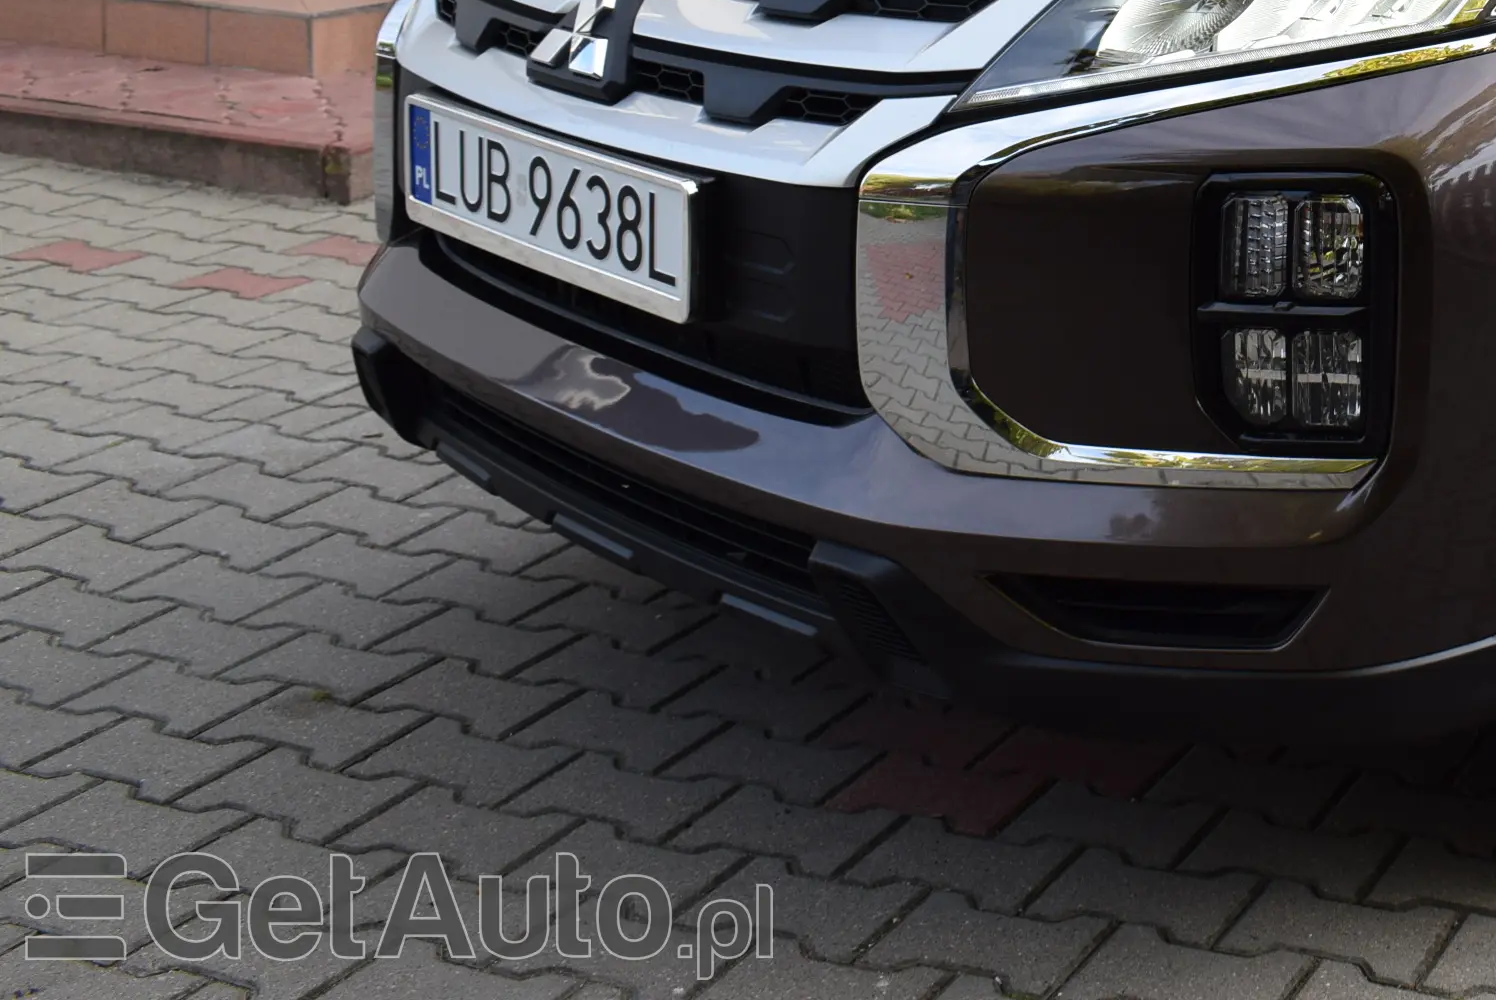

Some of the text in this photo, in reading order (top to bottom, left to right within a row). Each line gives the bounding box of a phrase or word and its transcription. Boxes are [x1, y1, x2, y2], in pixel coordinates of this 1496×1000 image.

[415, 165, 430, 189] PL
[434, 121, 676, 287] LUB 9638L
